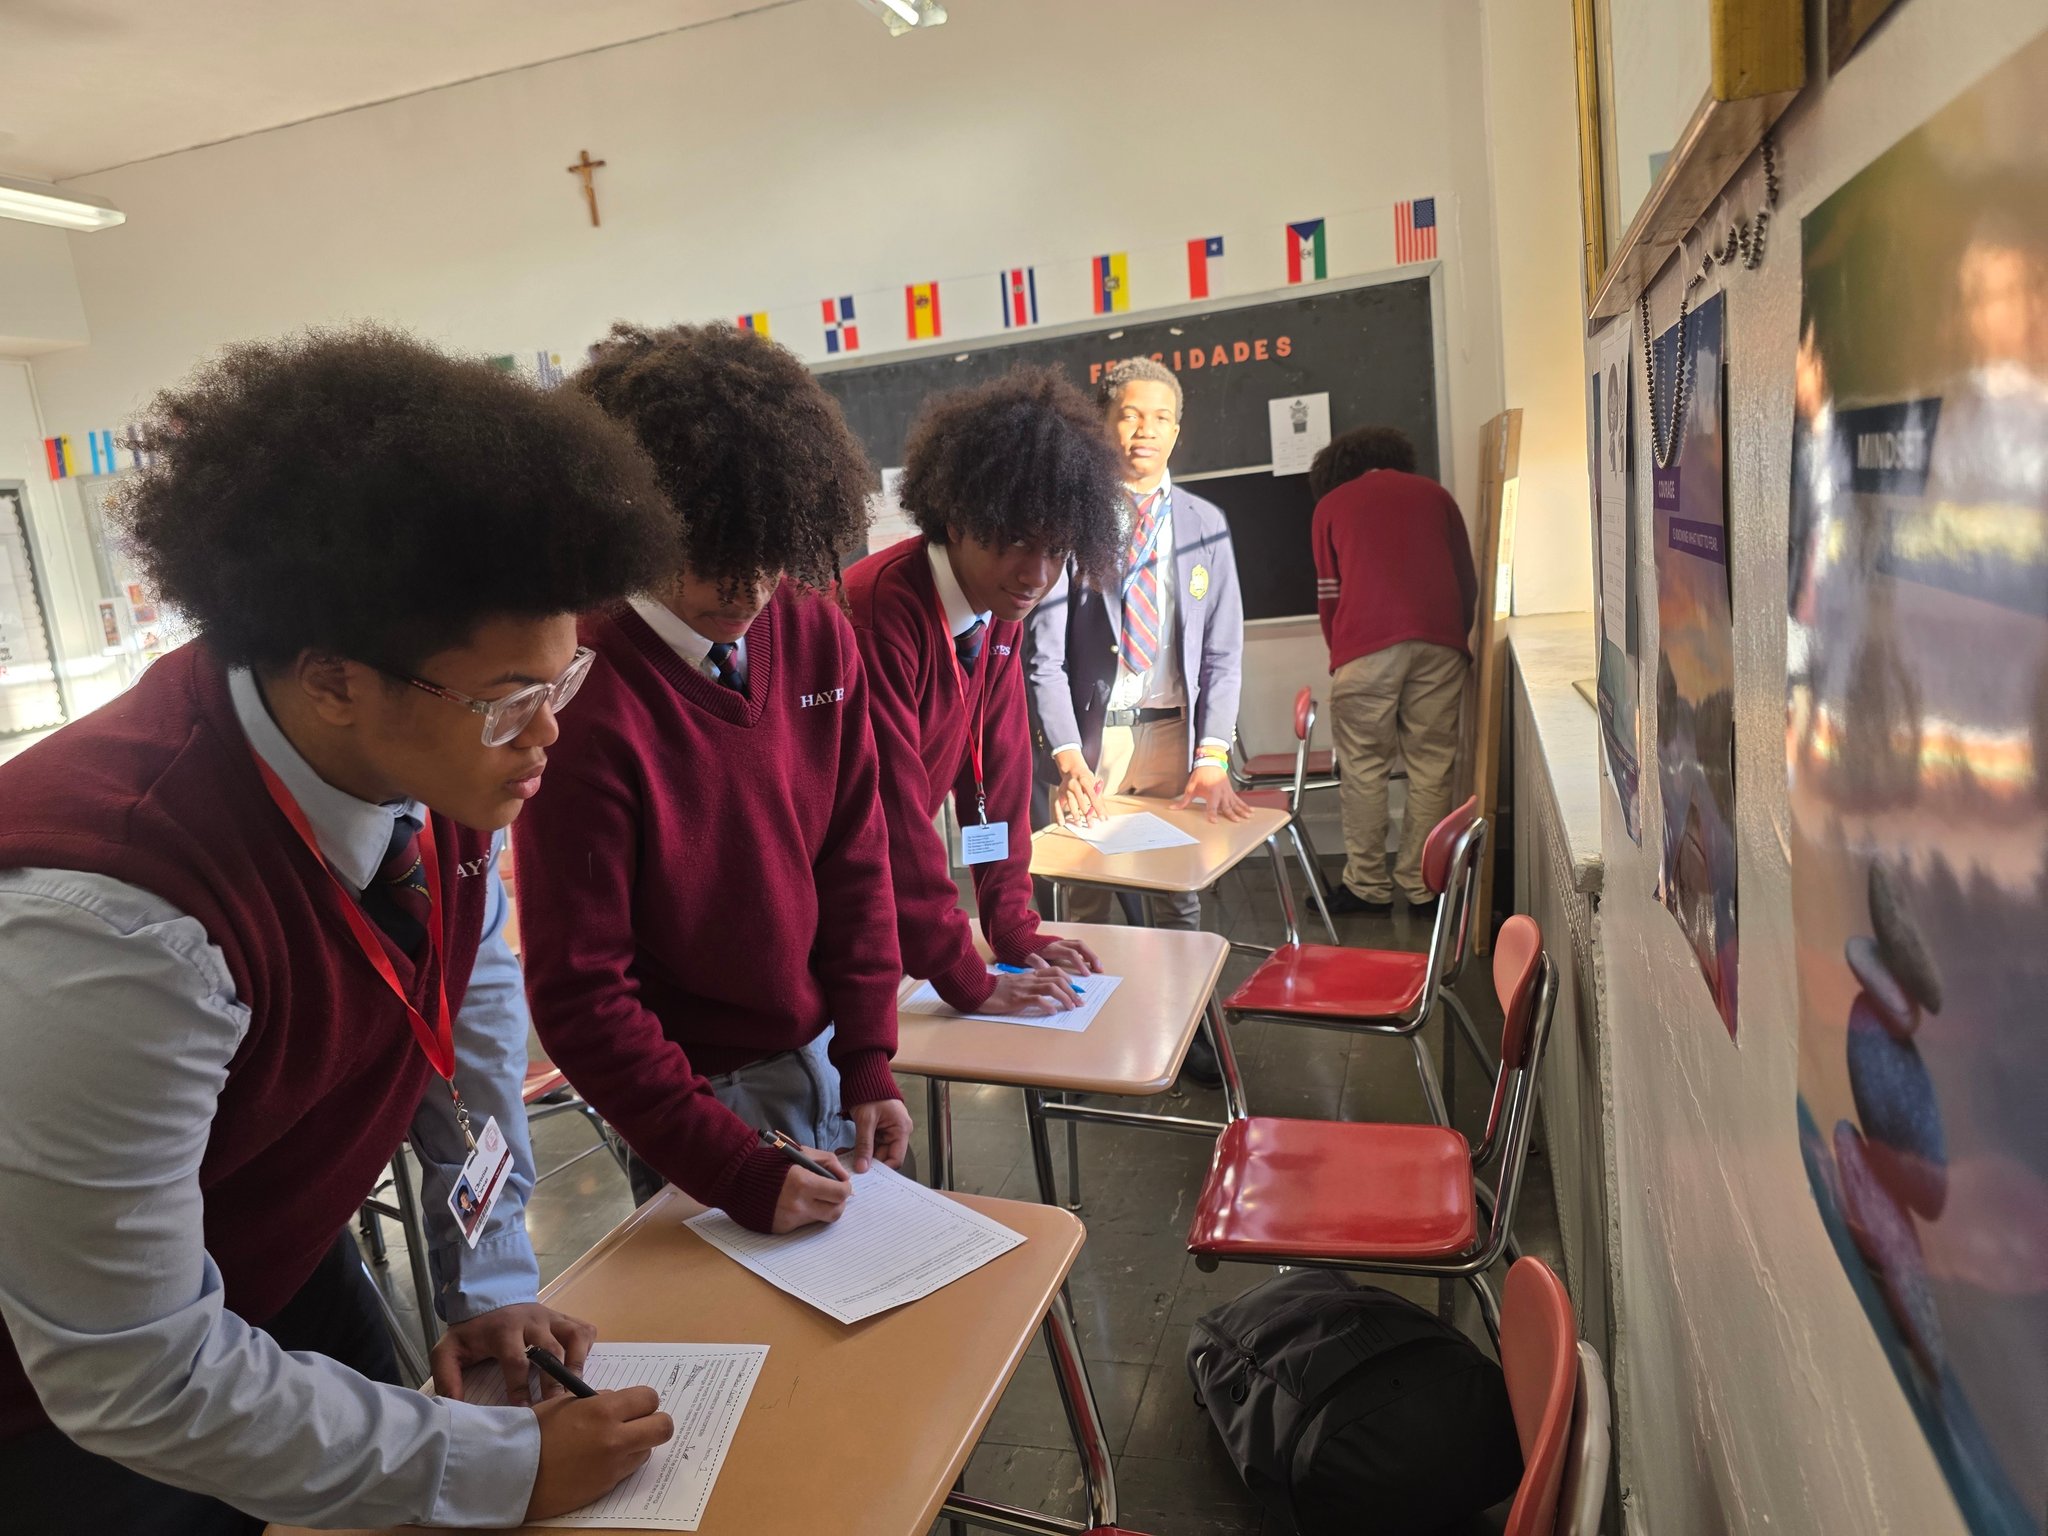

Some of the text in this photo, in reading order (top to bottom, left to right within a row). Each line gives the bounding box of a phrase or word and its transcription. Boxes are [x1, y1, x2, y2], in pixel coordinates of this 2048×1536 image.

[1089, 336, 1293, 384] FECIDADES
[1857, 430, 1926, 471] MINDSET
[800, 687, 845, 708] HAYE
